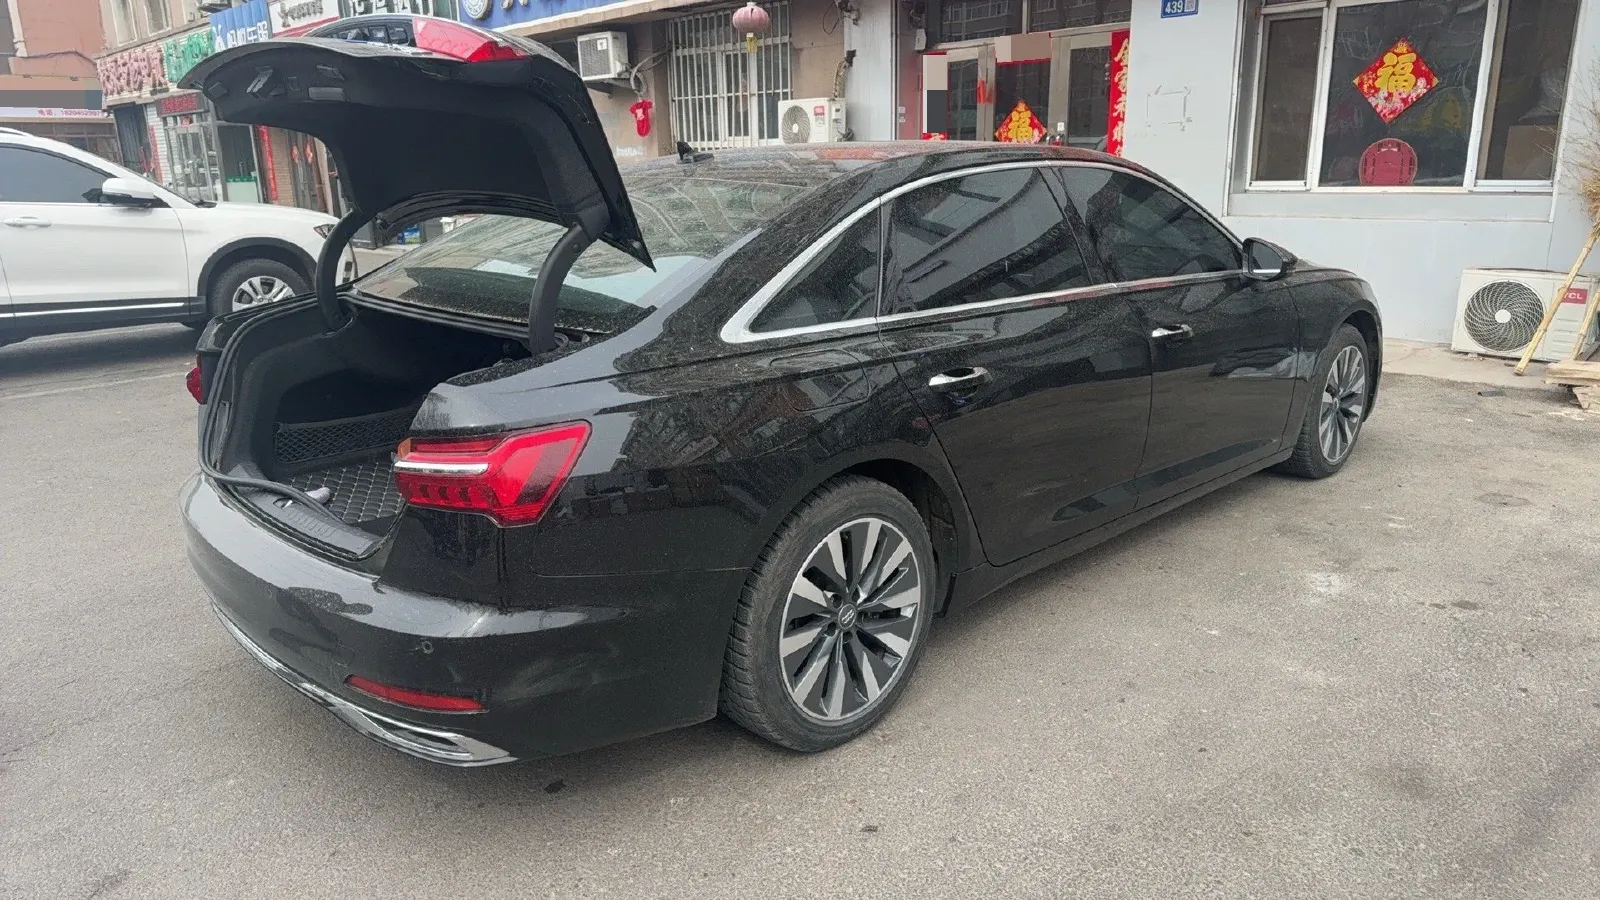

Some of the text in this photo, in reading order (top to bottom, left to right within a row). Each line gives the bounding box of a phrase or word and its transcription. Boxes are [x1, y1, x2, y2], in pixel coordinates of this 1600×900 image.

[1165, 1, 1184, 14] 439
[1374, 52, 1417, 94] 福
[1008, 110, 1033, 141] 福
